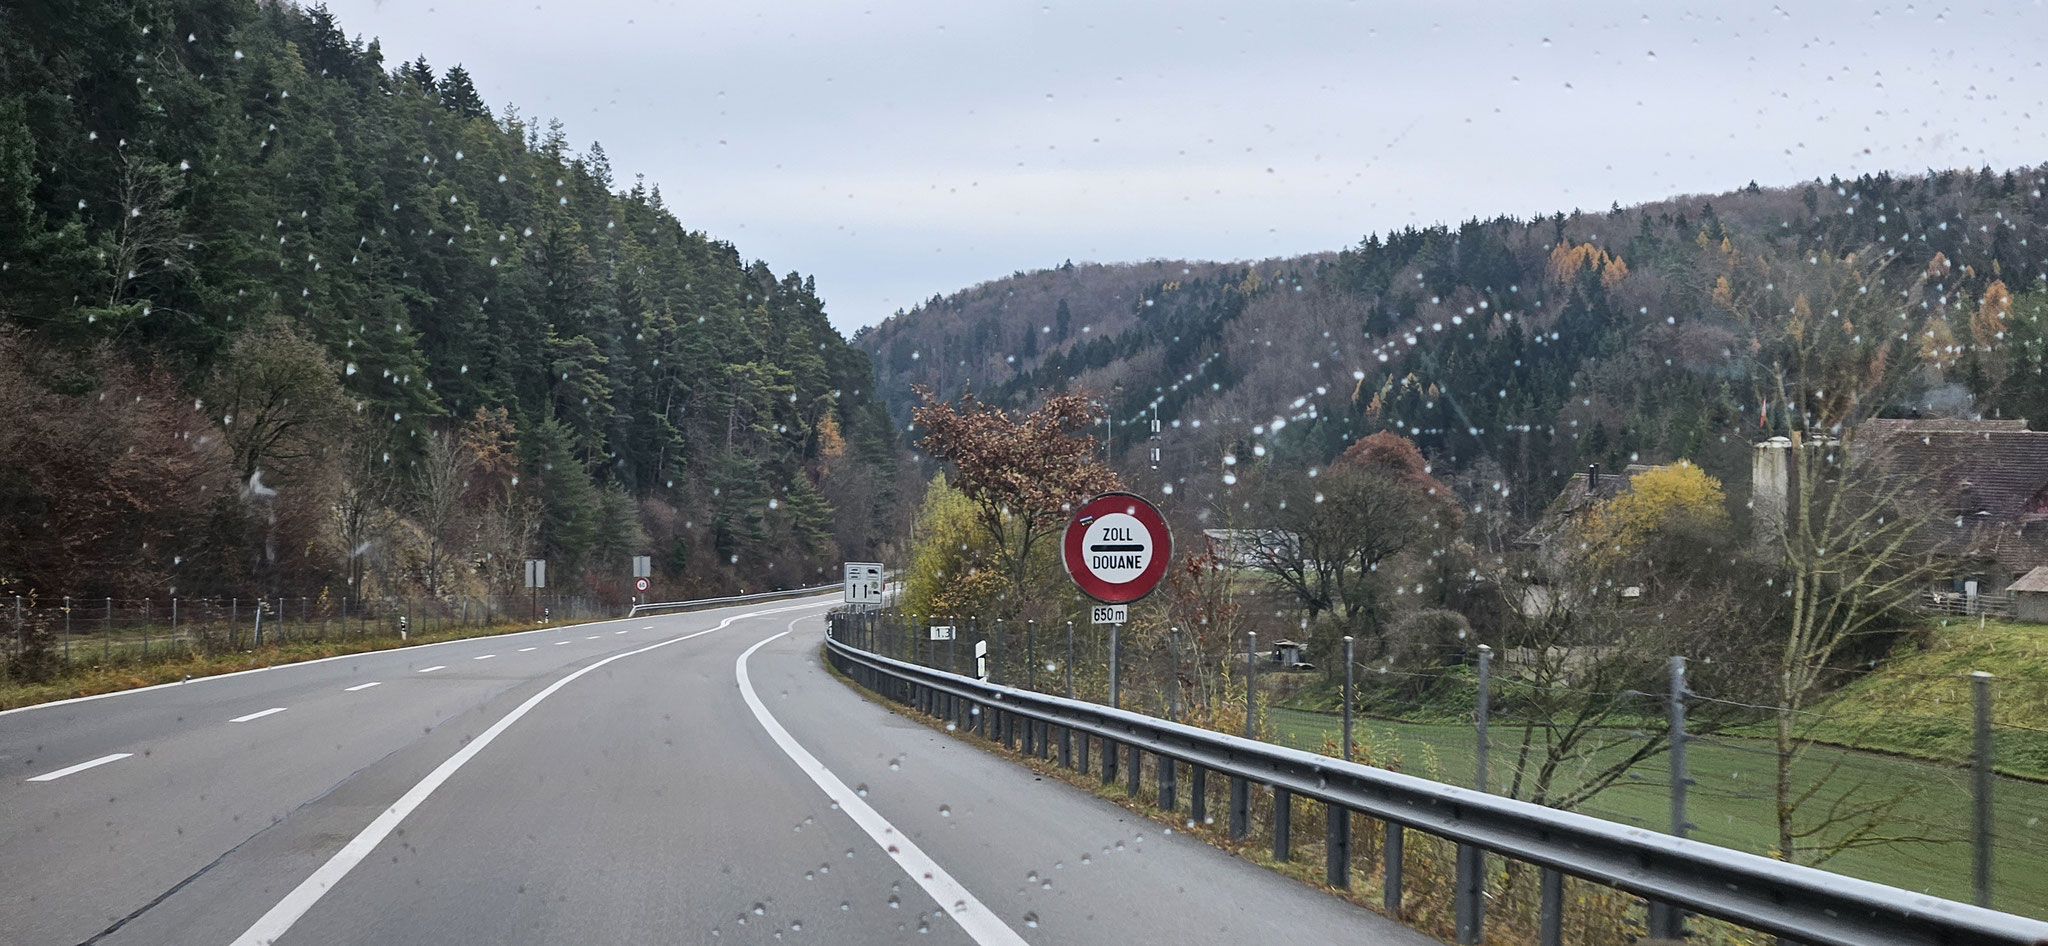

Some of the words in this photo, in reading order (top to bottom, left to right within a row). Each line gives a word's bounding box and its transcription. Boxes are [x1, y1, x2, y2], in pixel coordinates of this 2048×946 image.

[1103, 528, 1133, 541] ZOLL
[1093, 556, 1142, 569] DOUANE
[1094, 608, 1113, 621] 650
[1115, 610, 1124, 620] m
